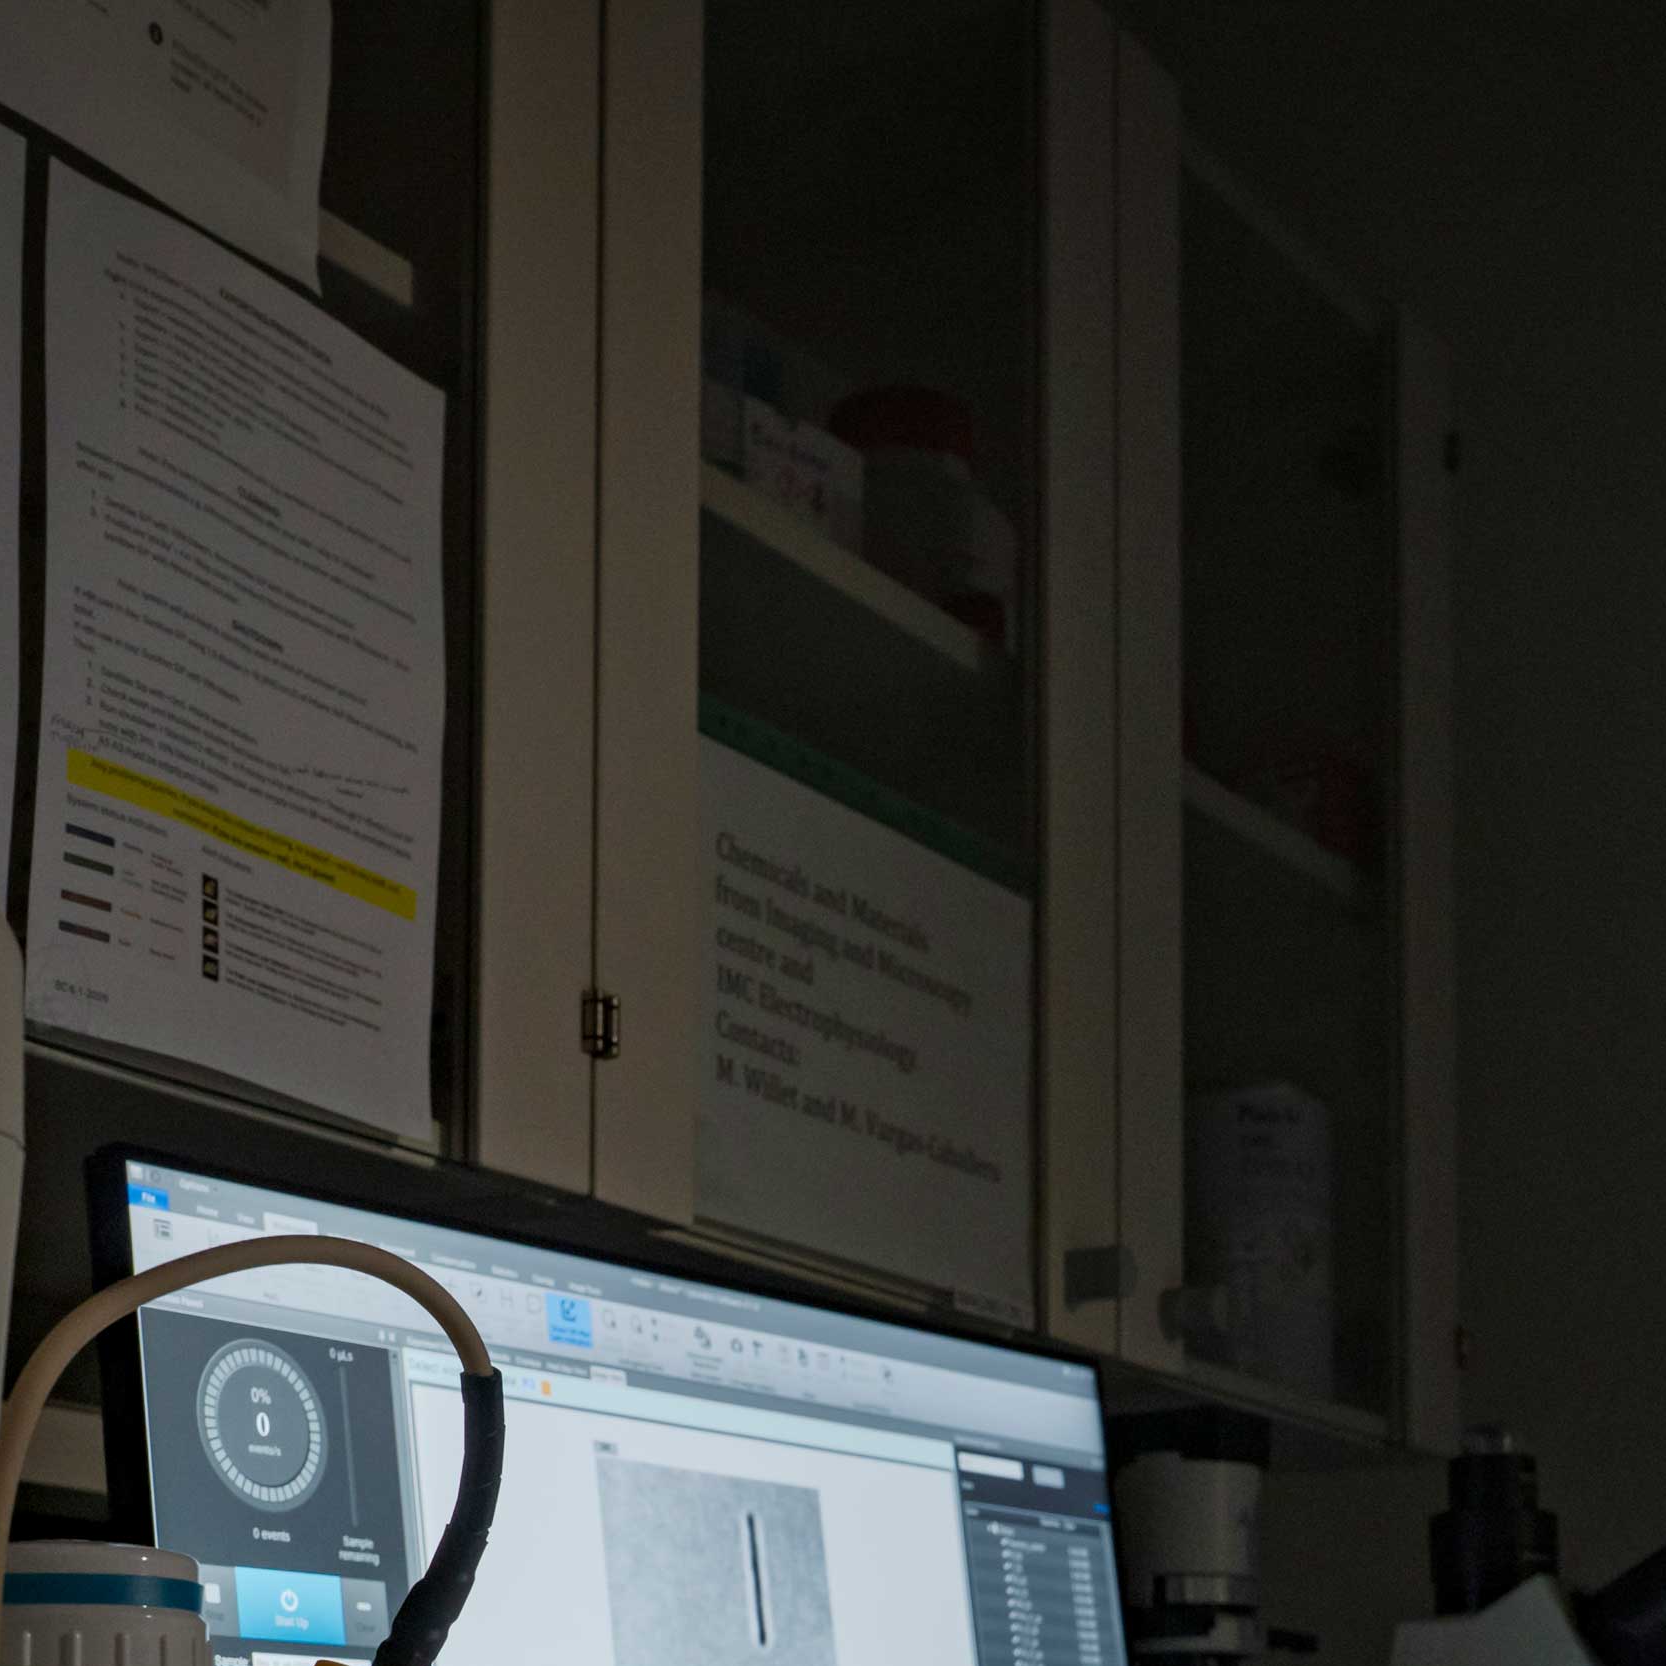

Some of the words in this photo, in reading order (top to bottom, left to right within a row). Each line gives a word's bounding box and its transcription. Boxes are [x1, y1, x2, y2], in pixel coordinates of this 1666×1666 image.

[716, 831, 810, 900] Chemicals
[812, 882, 847, 915] and
[850, 893, 930, 955] Materials
[716, 874, 762, 919] from
[765, 895, 840, 962] Imaging
[842, 936, 876, 971] and
[779, 949, 814, 986] and
[802, 1093, 838, 1123] and
[249, 1386, 272, 1406] 0%
[255, 1411, 271, 1437] 0
[252, 1527, 260, 1539] 0
[261, 1529, 291, 1543] events
[342, 1535, 375, 1551] Sample
[338, 1550, 381, 1567] remaining
